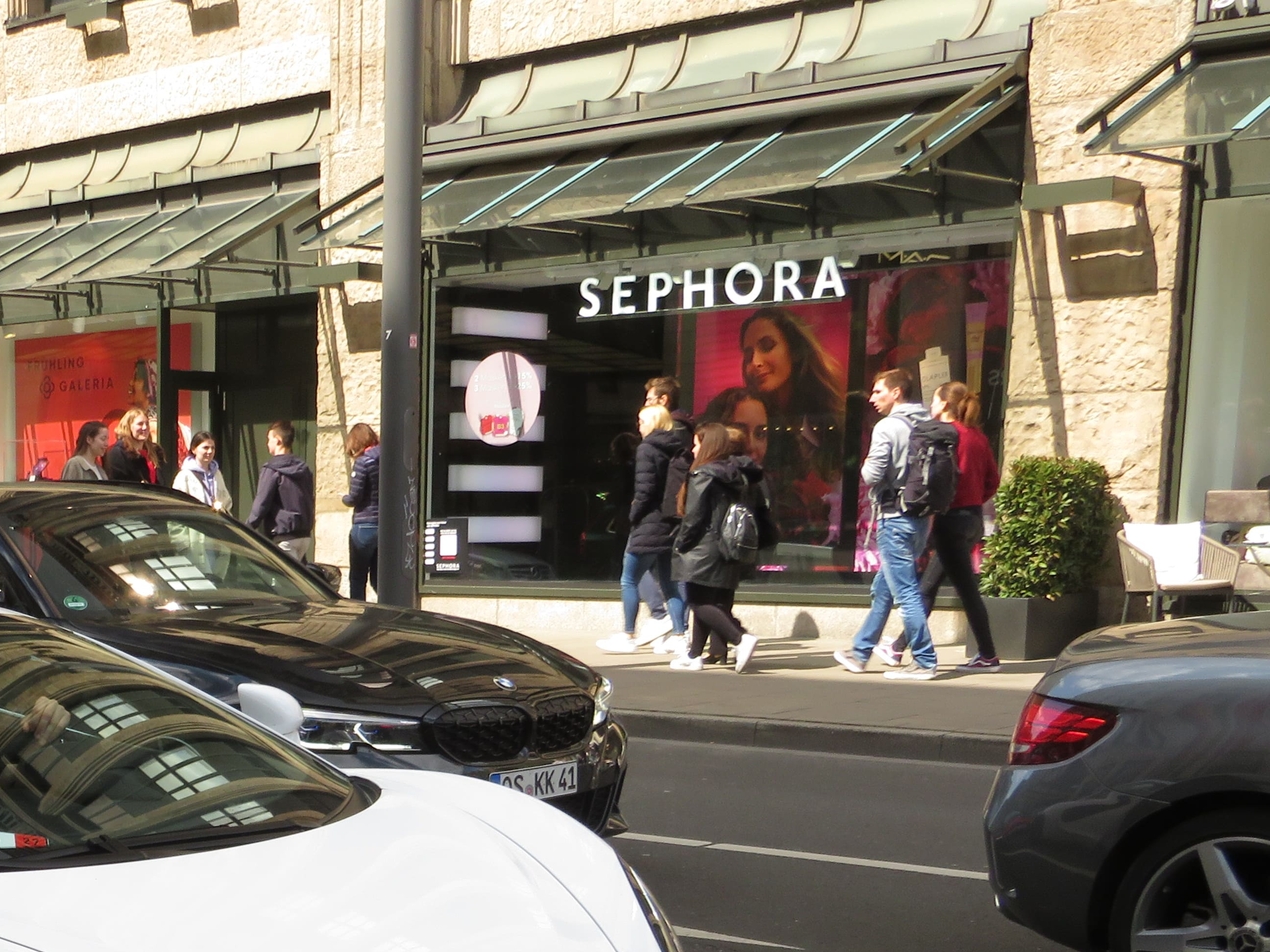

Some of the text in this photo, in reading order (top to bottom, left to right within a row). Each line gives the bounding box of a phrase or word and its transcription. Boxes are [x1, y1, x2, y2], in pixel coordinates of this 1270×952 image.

[578, 256, 846, 318] SEPHORA
[59, 377, 114, 392] GALERIA
[534, 769, 556, 796] KK
[558, 766, 576, 792] 41
